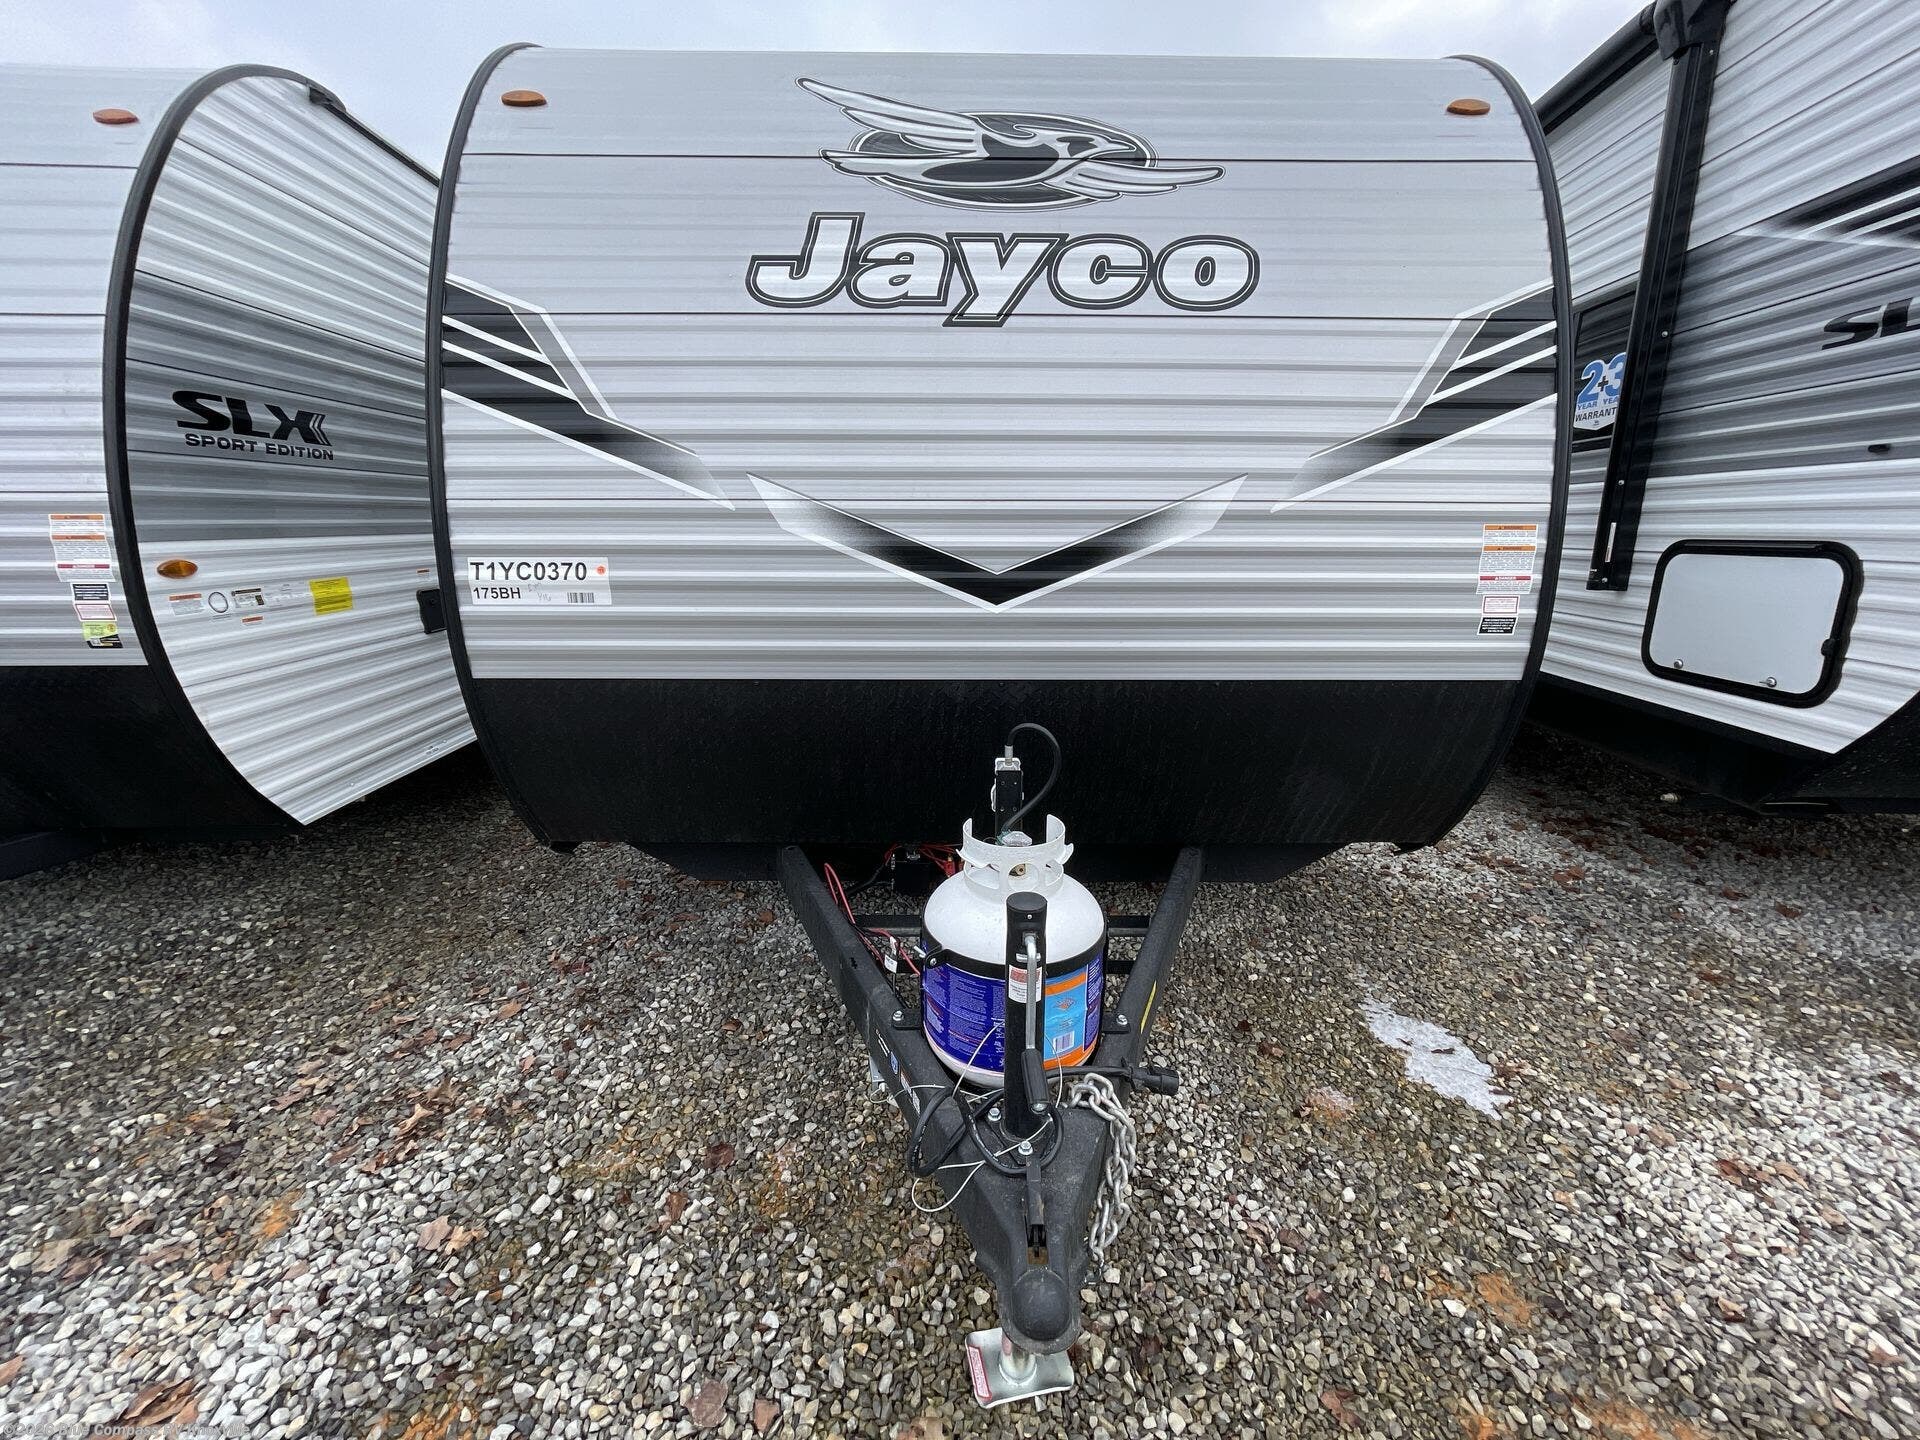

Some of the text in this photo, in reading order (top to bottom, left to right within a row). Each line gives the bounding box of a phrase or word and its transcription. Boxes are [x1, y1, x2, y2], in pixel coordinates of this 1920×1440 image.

[745, 212, 1260, 327] Jayco
[1577, 396, 1618, 411] YEAR YEA
[172, 390, 331, 447] SLX
[1575, 407, 1617, 422] WARRANT
[185, 433, 334, 460] SPORT EDITION
[470, 562, 587, 581] T1YC0370
[473, 587, 521, 599] 175BH
